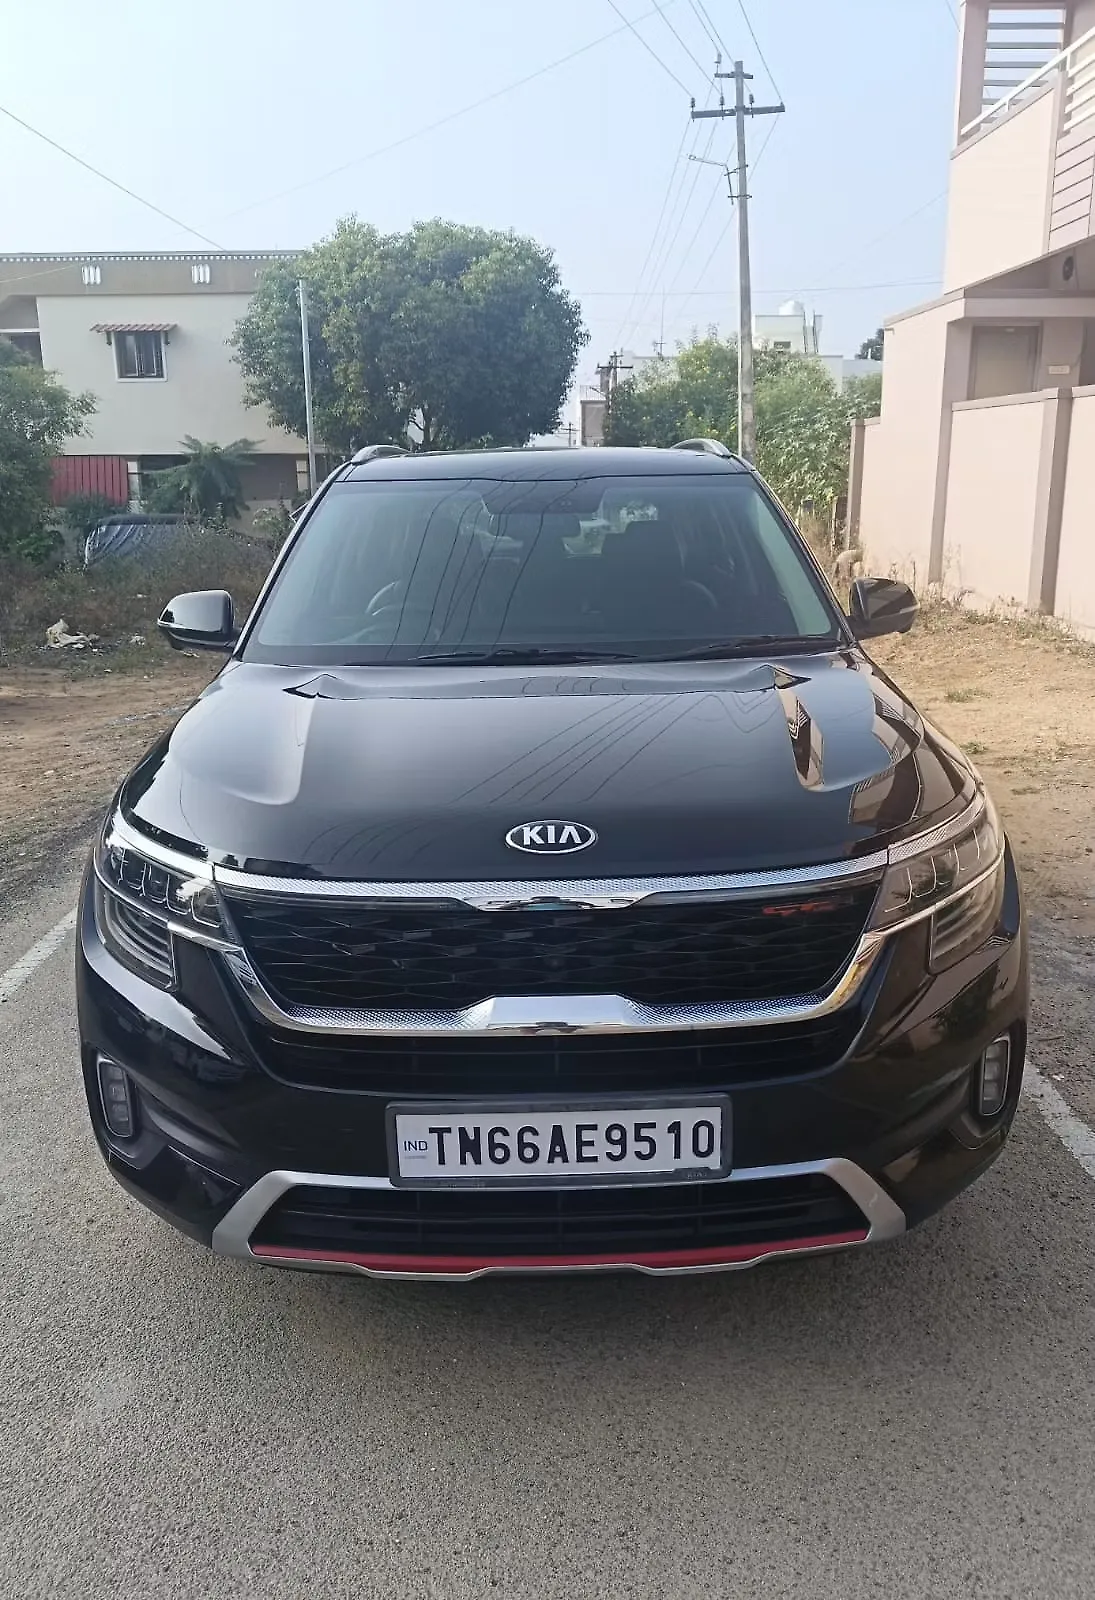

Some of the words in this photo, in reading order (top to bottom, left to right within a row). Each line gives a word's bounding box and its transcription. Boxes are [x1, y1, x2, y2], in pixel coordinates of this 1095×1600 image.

[522, 825, 582, 845] KIA
[404, 1140, 428, 1151] IND
[428, 1120, 715, 1165] TN66AE9510
